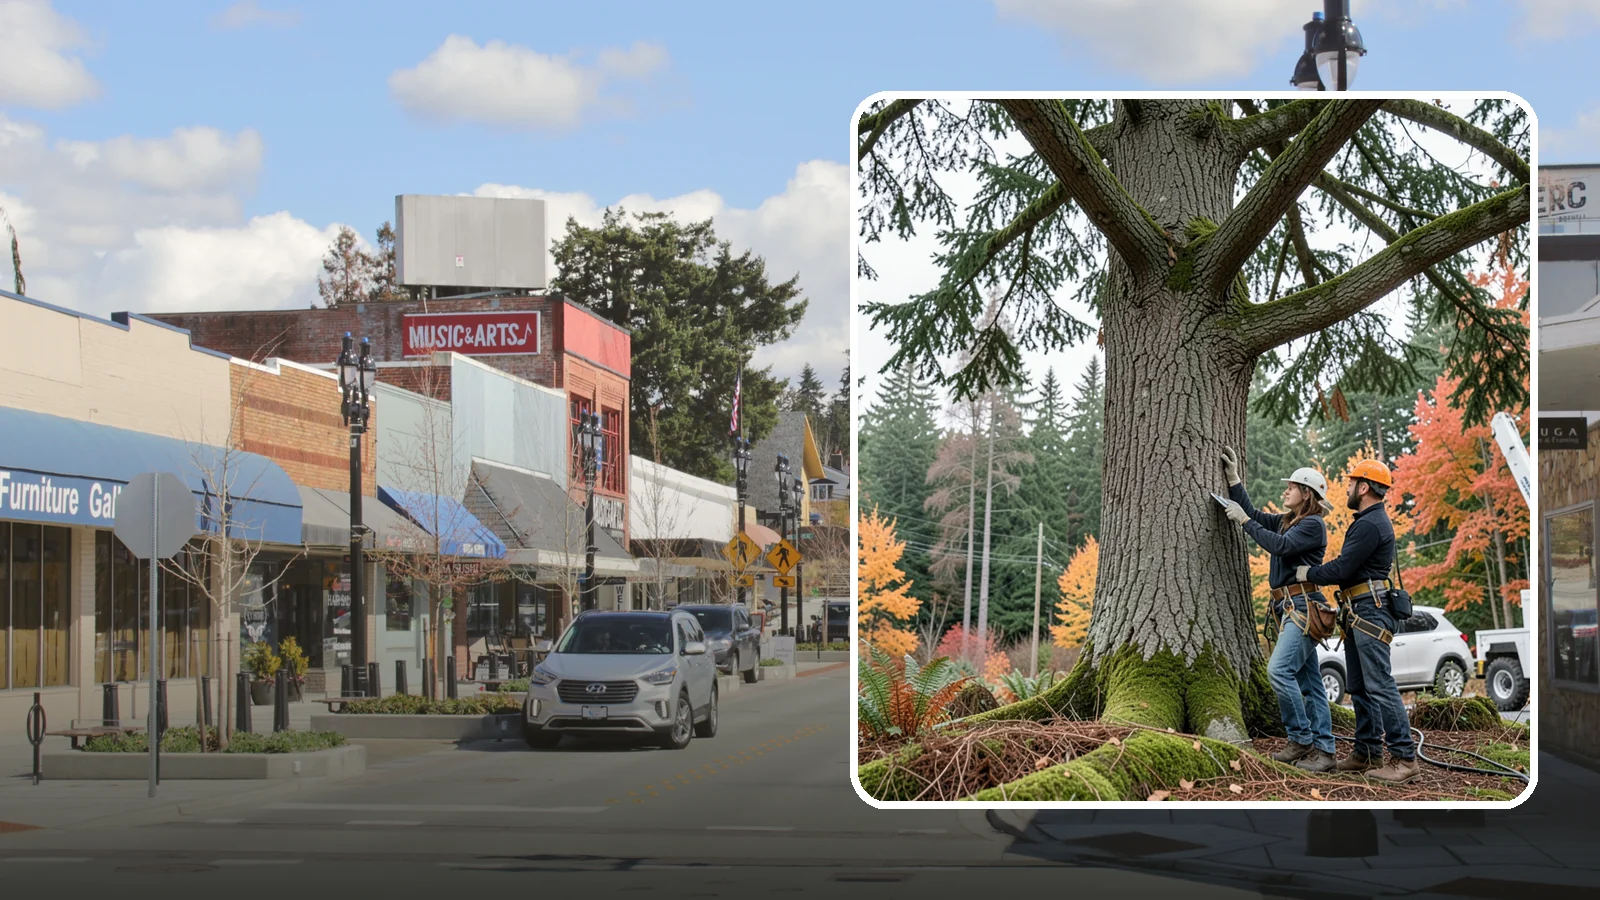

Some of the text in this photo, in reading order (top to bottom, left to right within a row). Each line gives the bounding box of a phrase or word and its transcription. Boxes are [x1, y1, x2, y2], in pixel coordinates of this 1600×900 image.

[1540, 427, 1578, 437] UGA
[0, 471, 121, 519] Furniture Gal
[453, 563, 479, 574] SUSHI
